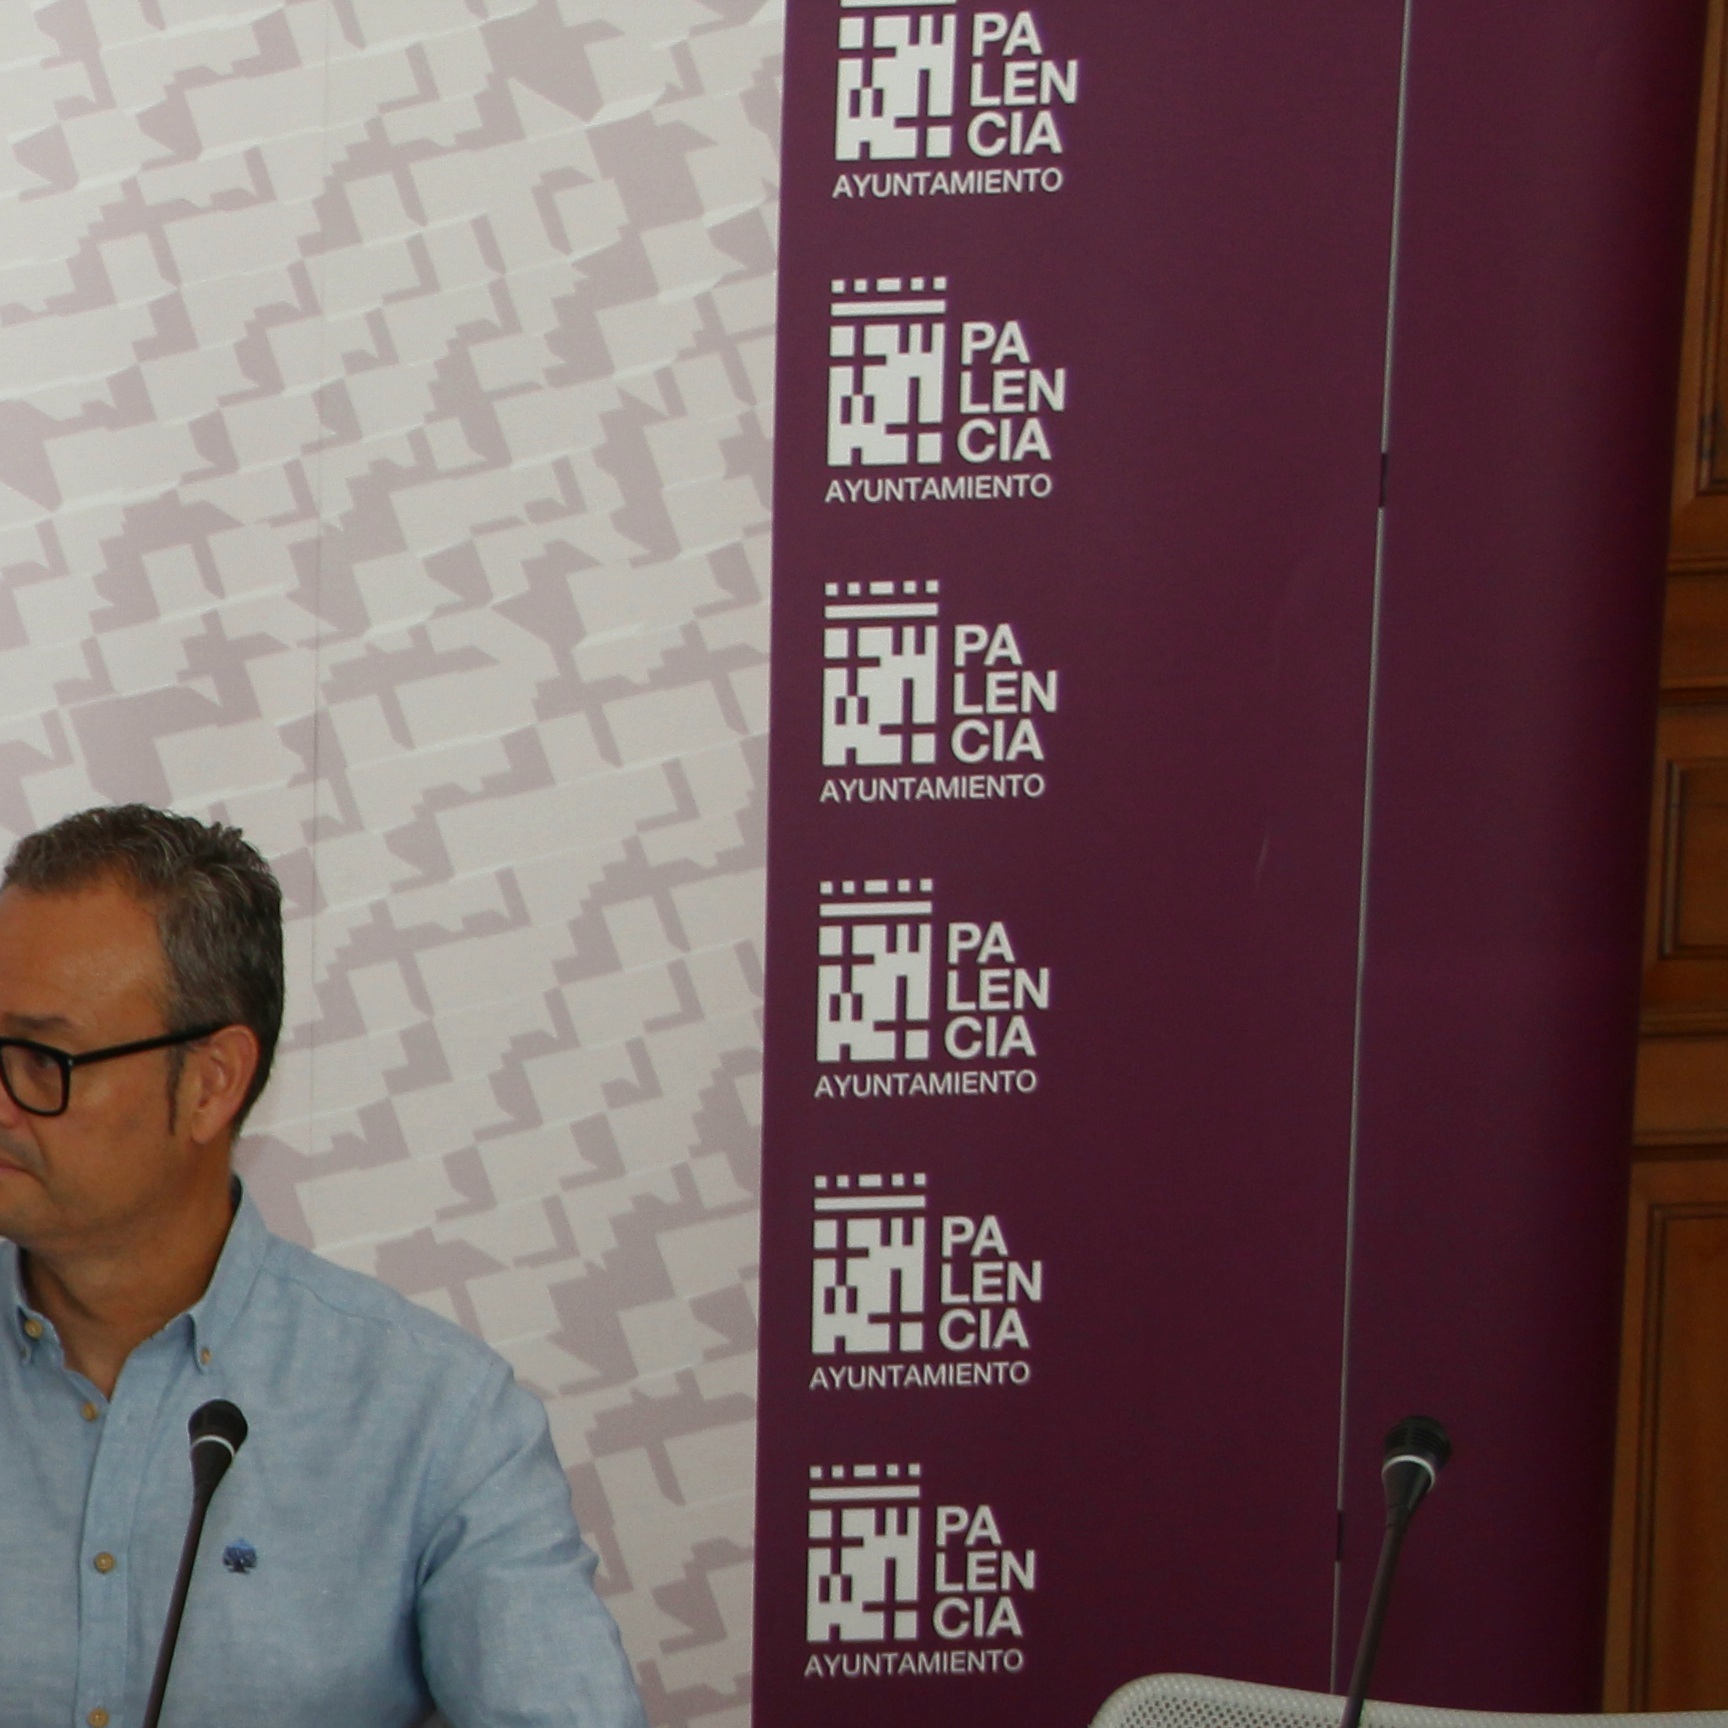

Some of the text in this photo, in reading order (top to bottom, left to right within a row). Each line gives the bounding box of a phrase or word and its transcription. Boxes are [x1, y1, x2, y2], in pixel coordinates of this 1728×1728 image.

[972, 11, 1041, 55] PA
[970, 60, 1077, 106] LEN
[966, 111, 1063, 157] CIA
[832, 167, 1063, 198] AYUNTAMIENTO
[961, 321, 1030, 365] PA
[960, 369, 1065, 413] LEN
[956, 418, 1051, 462] CIA
[825, 473, 1051, 503] AYUNTAMIENTO
[953, 624, 1022, 666] PA
[952, 671, 1057, 714] LEN
[950, 720, 1043, 763] CIA
[820, 773, 1044, 801] AYUNTAMIENTO
[948, 922, 1015, 964] PA
[947, 968, 1049, 1010] LEN
[944, 1016, 1036, 1058] CIA
[814, 1069, 1037, 1097] AYUNTAMIENTO
[942, 1217, 1007, 1258] PA
[940, 1262, 1041, 1303] LEN
[938, 1309, 1029, 1351] CIA
[810, 1362, 1030, 1389] AYUNTAMIENTO
[936, 1507, 1001, 1547] PA
[935, 1551, 1035, 1592] LEN
[933, 1598, 1022, 1639] CIA
[804, 1648, 1023, 1676] AYUNTAMIENTO
